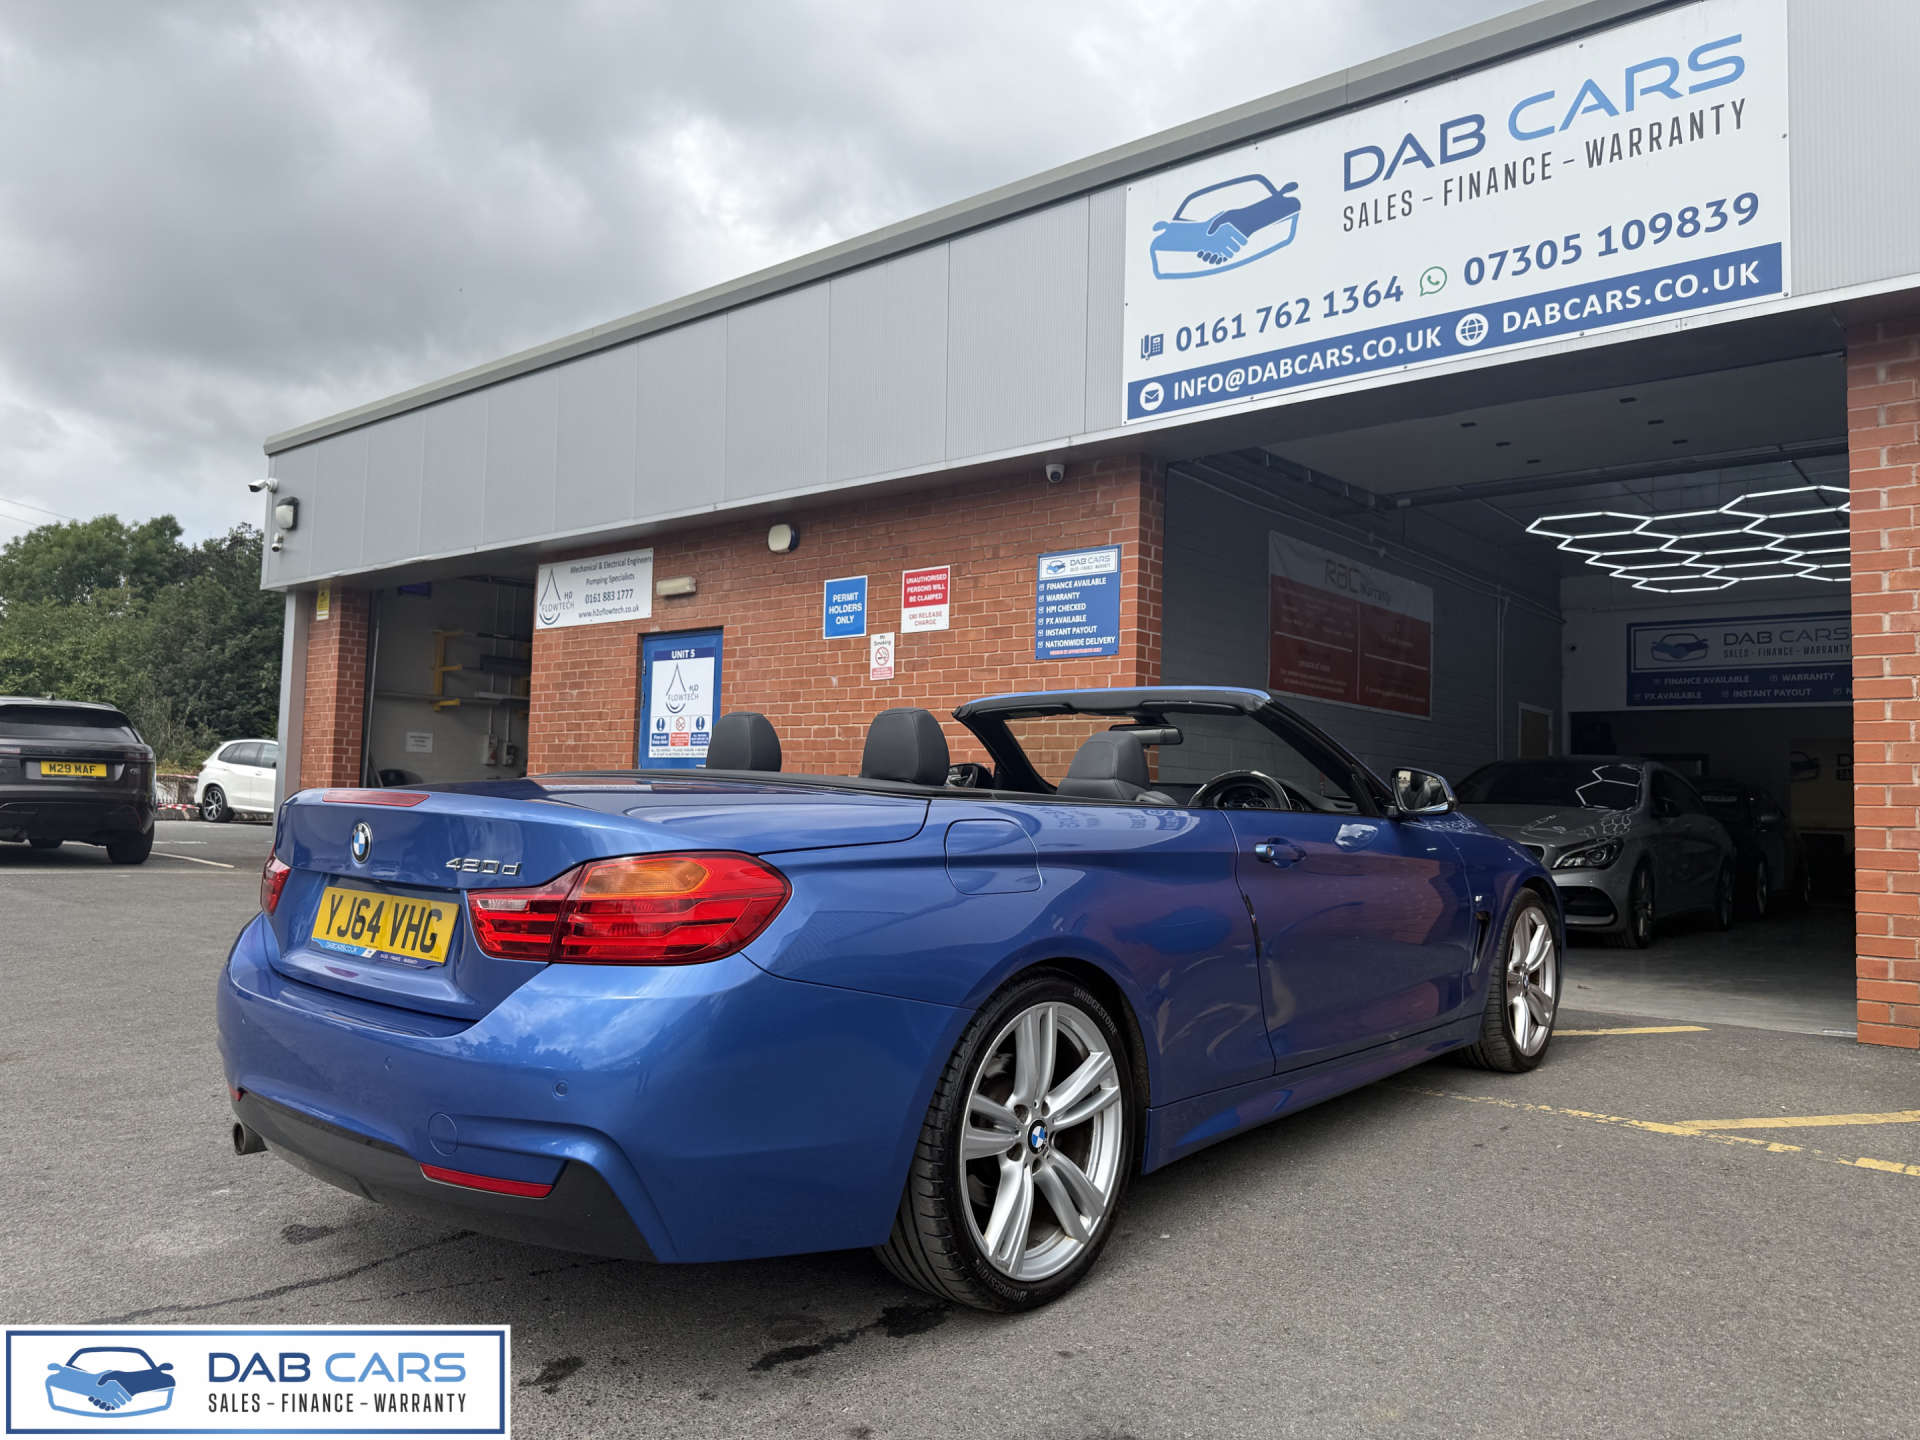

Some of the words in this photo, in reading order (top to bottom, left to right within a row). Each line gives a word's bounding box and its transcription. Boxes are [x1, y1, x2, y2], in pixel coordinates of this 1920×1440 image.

[1343, 113, 1486, 192] DAB
[1507, 33, 1746, 142] CARS
[1343, 189, 1413, 232] SALES
[1442, 151, 1553, 206] FINANCE
[1585, 98, 1747, 169] WARRANTY
[1175, 311, 1247, 352] 0161
[1256, 298, 1312, 336] 762
[1322, 276, 1404, 319] 1364
[1463, 233, 1583, 286] 07305
[1596, 191, 1760, 258] 109839
[1173, 326, 1442, 401] INFO@DABCARS.CO.UK
[1502, 260, 1760, 333] DABCARS.CO.UK
[1046, 581, 1073, 591] FINANCE
[1073, 577, 1107, 588] AVAILABLE
[832, 591, 859, 603] PERMIT
[1046, 592, 1081, 602] WARRANTY
[828, 603, 863, 614] HOLDERS
[1046, 606, 1057, 614] HPI
[1057, 603, 1087, 612] CHECKED
[835, 615, 855, 625] ONLY
[1045, 617, 1054, 625] PX
[1054, 614, 1087, 624] AVAILABLE
[1045, 627, 1072, 637] INSTANT
[1072, 625, 1098, 635] PAYOUT
[1723, 631, 1773, 646] DAB
[1779, 626, 1850, 643] CARS
[1045, 638, 1085, 649] NATIONWIDE
[1085, 636, 1116, 646] DELIVERY
[671, 649, 689, 659] UNIT
[689, 649, 696, 658] 5
[1758, 647, 1793, 657] FINANCE
[1782, 672, 1835, 682] WARRANTY
[1733, 689, 1772, 698] INSTANT
[1774, 687, 1812, 697] PAYOUT
[48, 763, 73, 774] M29
[74, 763, 97, 775] MAF
[445, 857, 521, 877] 420d
[326, 894, 385, 943] YJ64
[389, 902, 443, 953] VHG
